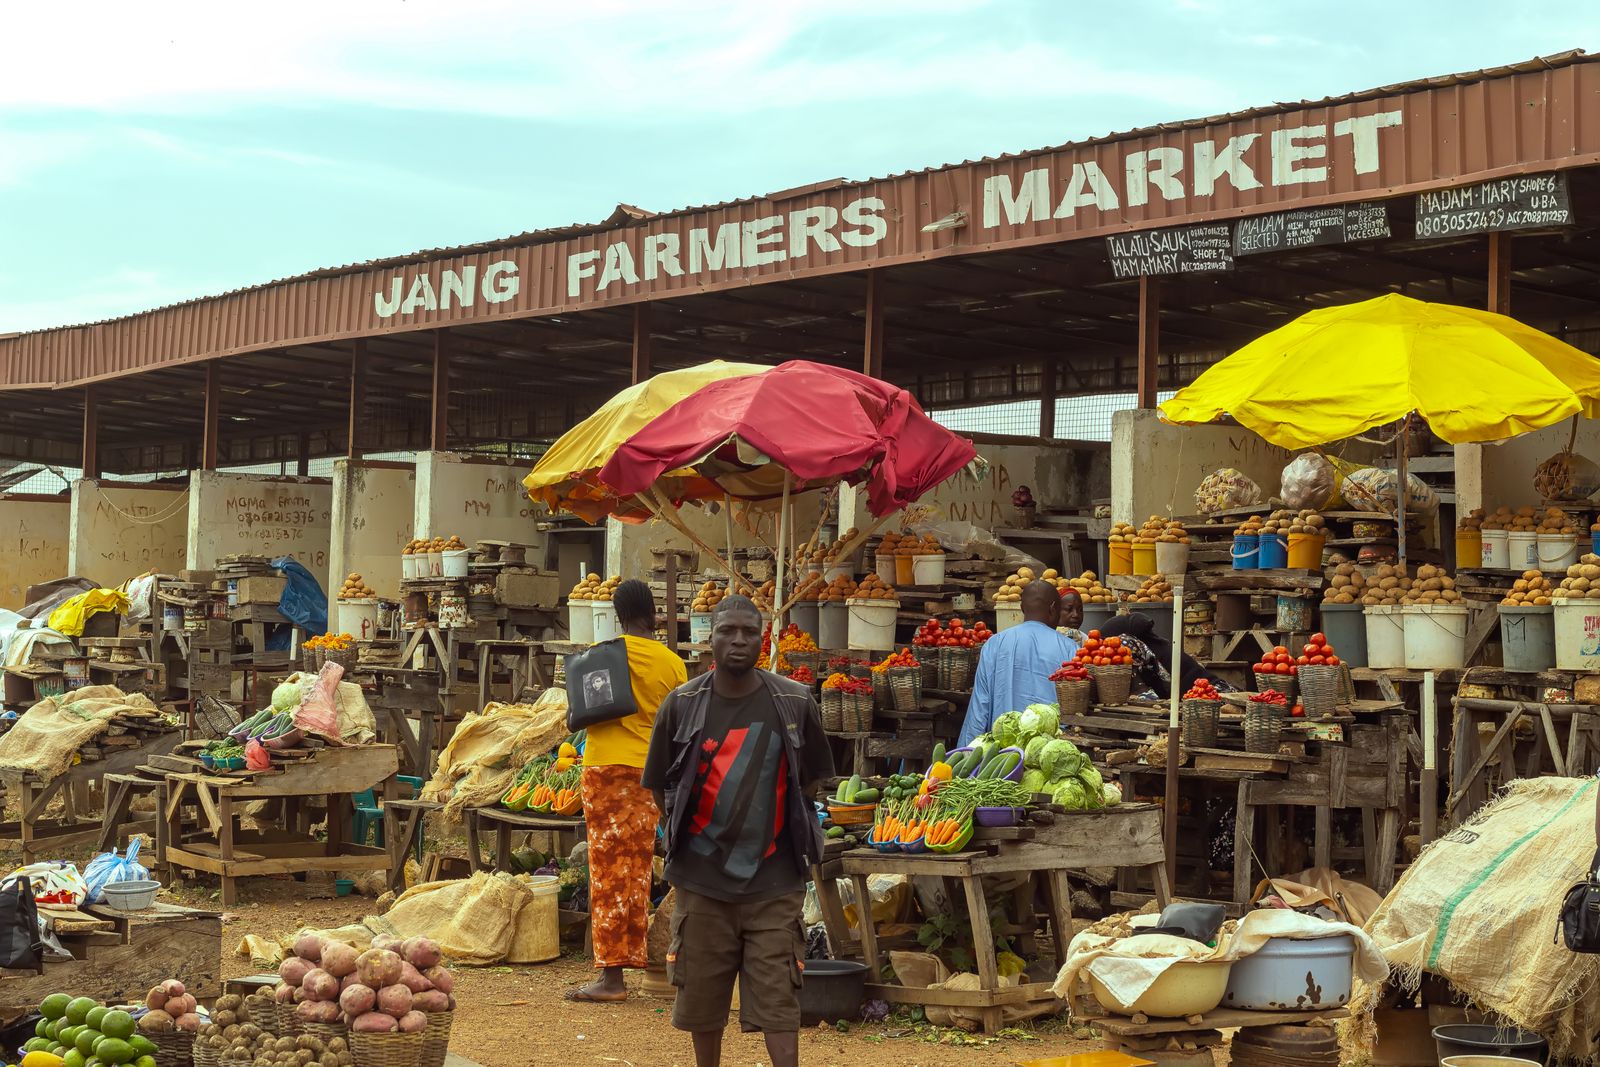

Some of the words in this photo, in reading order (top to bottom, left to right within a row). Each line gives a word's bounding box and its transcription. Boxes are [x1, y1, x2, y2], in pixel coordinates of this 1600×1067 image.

[1420, 187, 1472, 214] MADAM
[1481, 179, 1518, 205] MARY
[1519, 178, 1547, 193] SHOPE
[375, 260, 519, 318] JANG
[568, 197, 887, 296] FARMERS
[983, 110, 1401, 228] MARKET
[1242, 214, 1284, 235] MADAM
[1241, 232, 1279, 250] SELECTED
[1193, 249, 1217, 260] SHOPE
